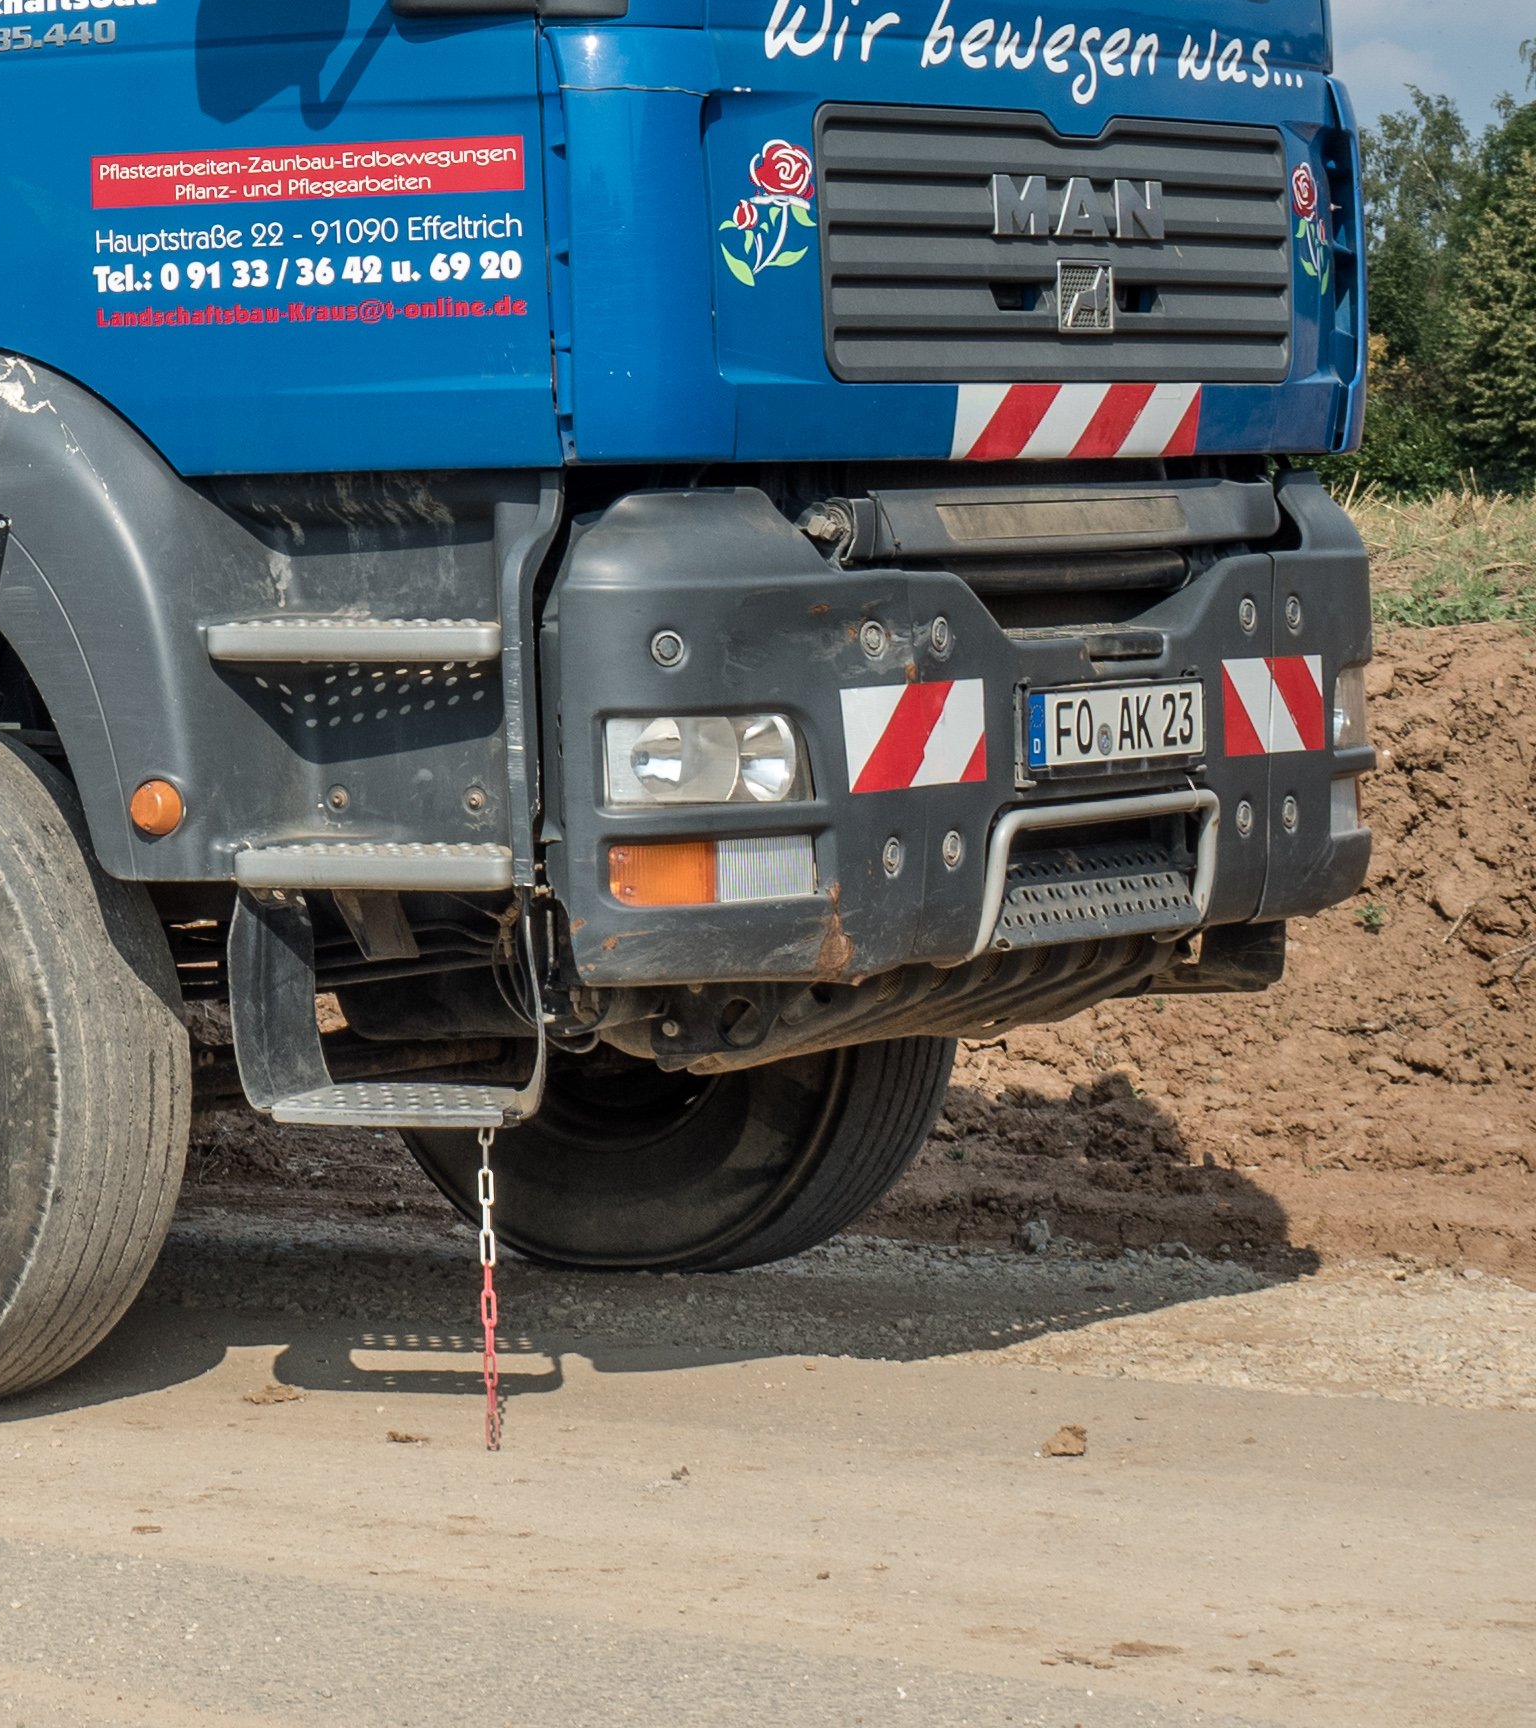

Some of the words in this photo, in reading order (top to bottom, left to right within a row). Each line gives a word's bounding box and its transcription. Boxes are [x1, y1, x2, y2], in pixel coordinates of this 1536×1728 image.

[1178, 27, 1304, 90] was...
[175, 181, 237, 201] Pflanz-
[243, 180, 282, 198] und
[288, 174, 432, 198] Pflegearbeiten
[990, 173, 1164, 240] MAN
[95, 222, 243, 257] Hauptstraße
[252, 222, 284, 248] 22
[311, 217, 398, 245] 91090
[408, 213, 523, 242] Effeltrich
[92, 263, 153, 293] Tel.:
[160, 263, 180, 291] 0
[187, 261, 221, 290] 91
[232, 259, 269, 288] 33
[275, 258, 290, 290] /
[296, 256, 335, 287] 36
[342, 254, 383, 285] 42
[392, 259, 422, 283] u.
[430, 252, 471, 281] 69
[480, 249, 522, 279] 20
[96, 295, 527, 328] Landschaftsbau-Kraus@t-online.de
[1056, 698, 1094, 755] FO
[1118, 694, 1154, 751] AK
[1162, 690, 1194, 746] 23
[1033, 738, 1041, 754] D
